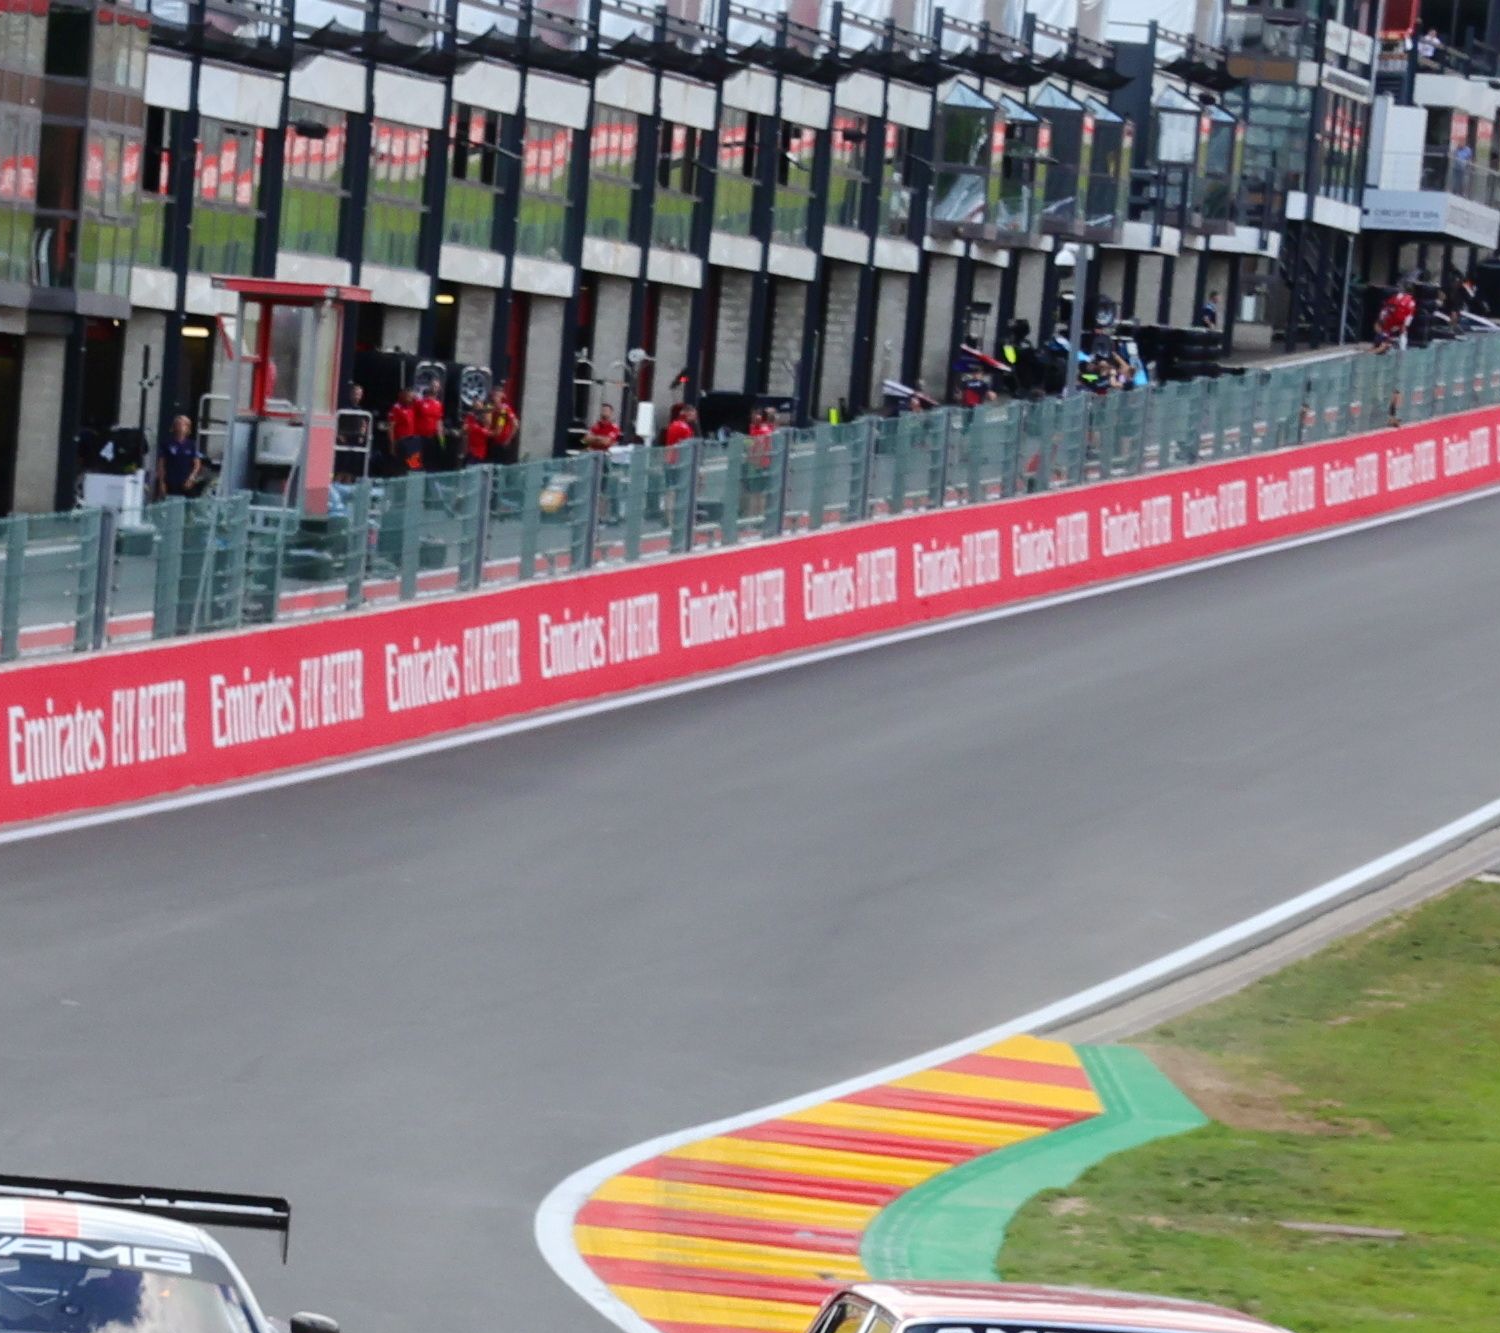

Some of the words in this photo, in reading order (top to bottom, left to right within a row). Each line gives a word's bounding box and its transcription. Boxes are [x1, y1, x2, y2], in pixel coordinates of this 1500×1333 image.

[210, 666, 295, 749] Emirates
[384, 636, 460, 713] Emirates
[7, 697, 107, 786] Emirates
[112, 687, 137, 768] FLY
[137, 679, 187, 763] BETTER
